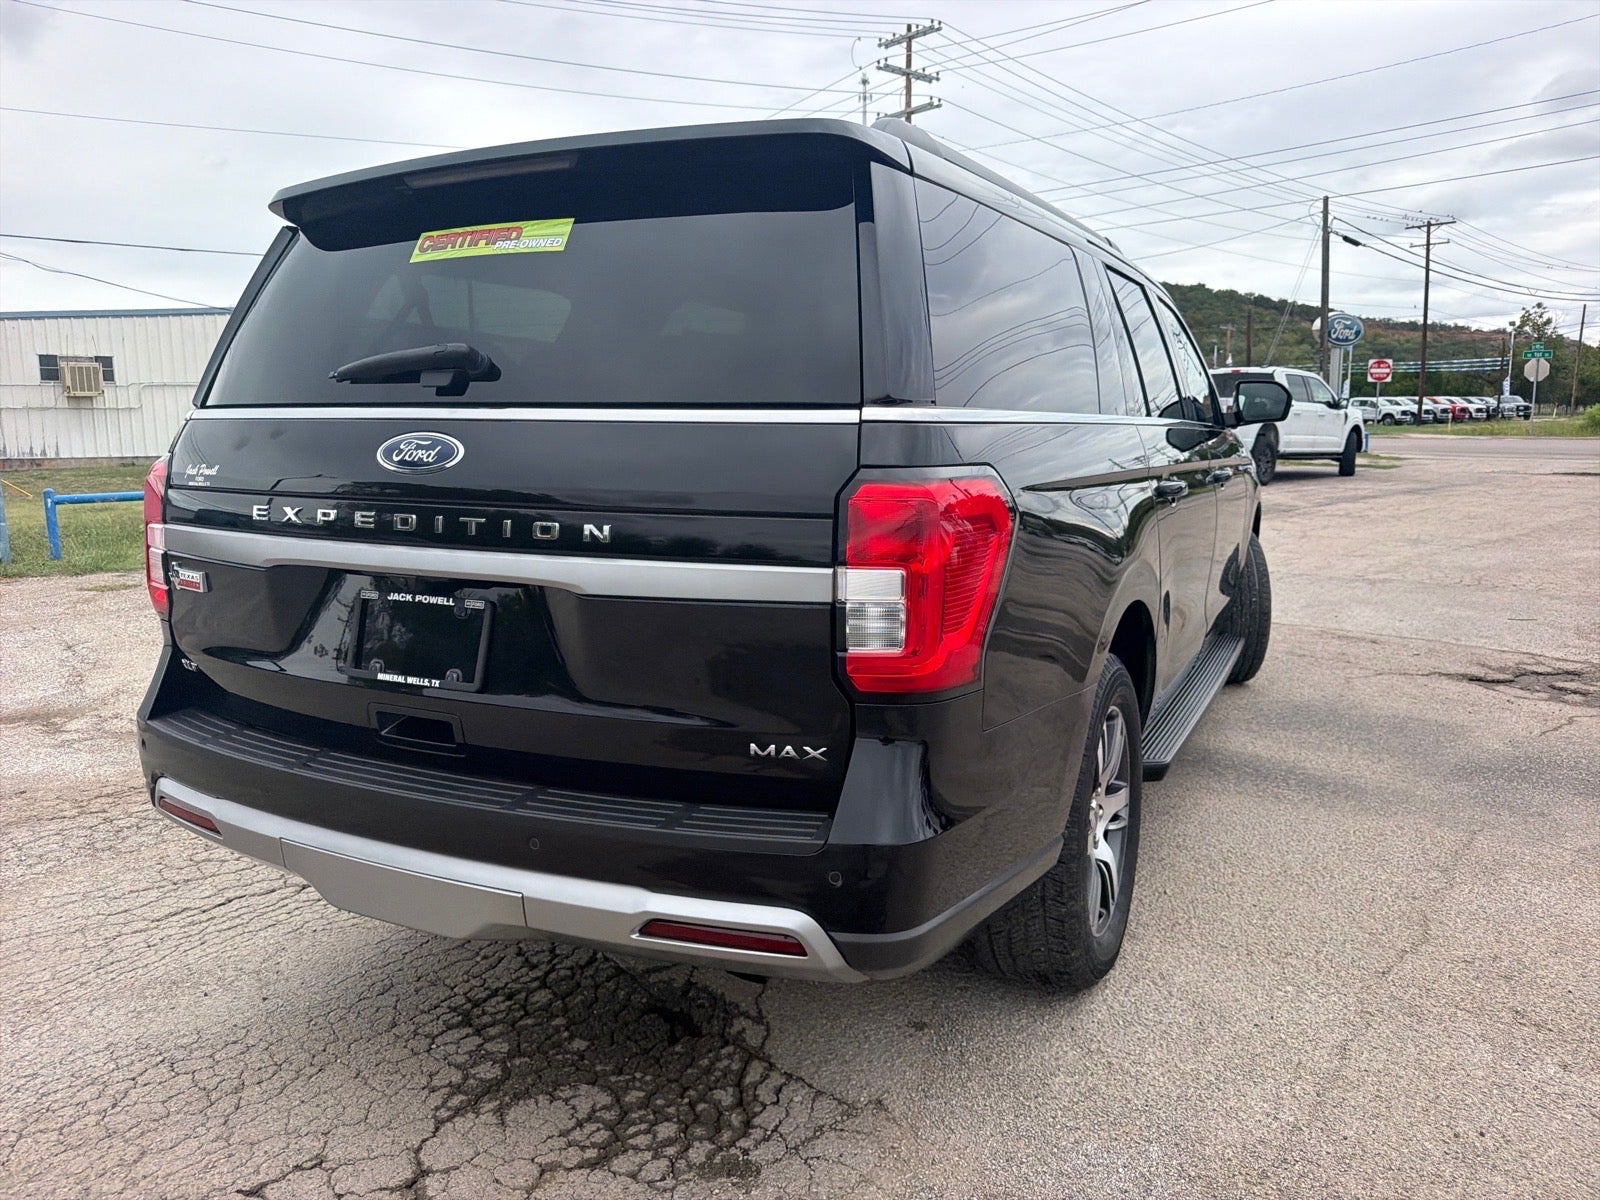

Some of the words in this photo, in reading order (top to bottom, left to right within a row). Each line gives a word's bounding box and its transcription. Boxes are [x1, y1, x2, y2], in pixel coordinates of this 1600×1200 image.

[418, 226, 523, 254] CERTIFIED
[494, 238, 563, 250] PRE-OWNED
[1331, 319, 1357, 340] Ford
[392, 439, 442, 463] Ford
[252, 505, 612, 543] EXPEDITION
[180, 572, 199, 582] TEXAS
[387, 593, 413, 602] JACK
[415, 594, 455, 606] POWELL
[377, 673, 406, 683] MINERAL
[406, 676, 430, 687] WELLS,
[431, 679, 440, 687] TX
[749, 742, 828, 761] MAX
